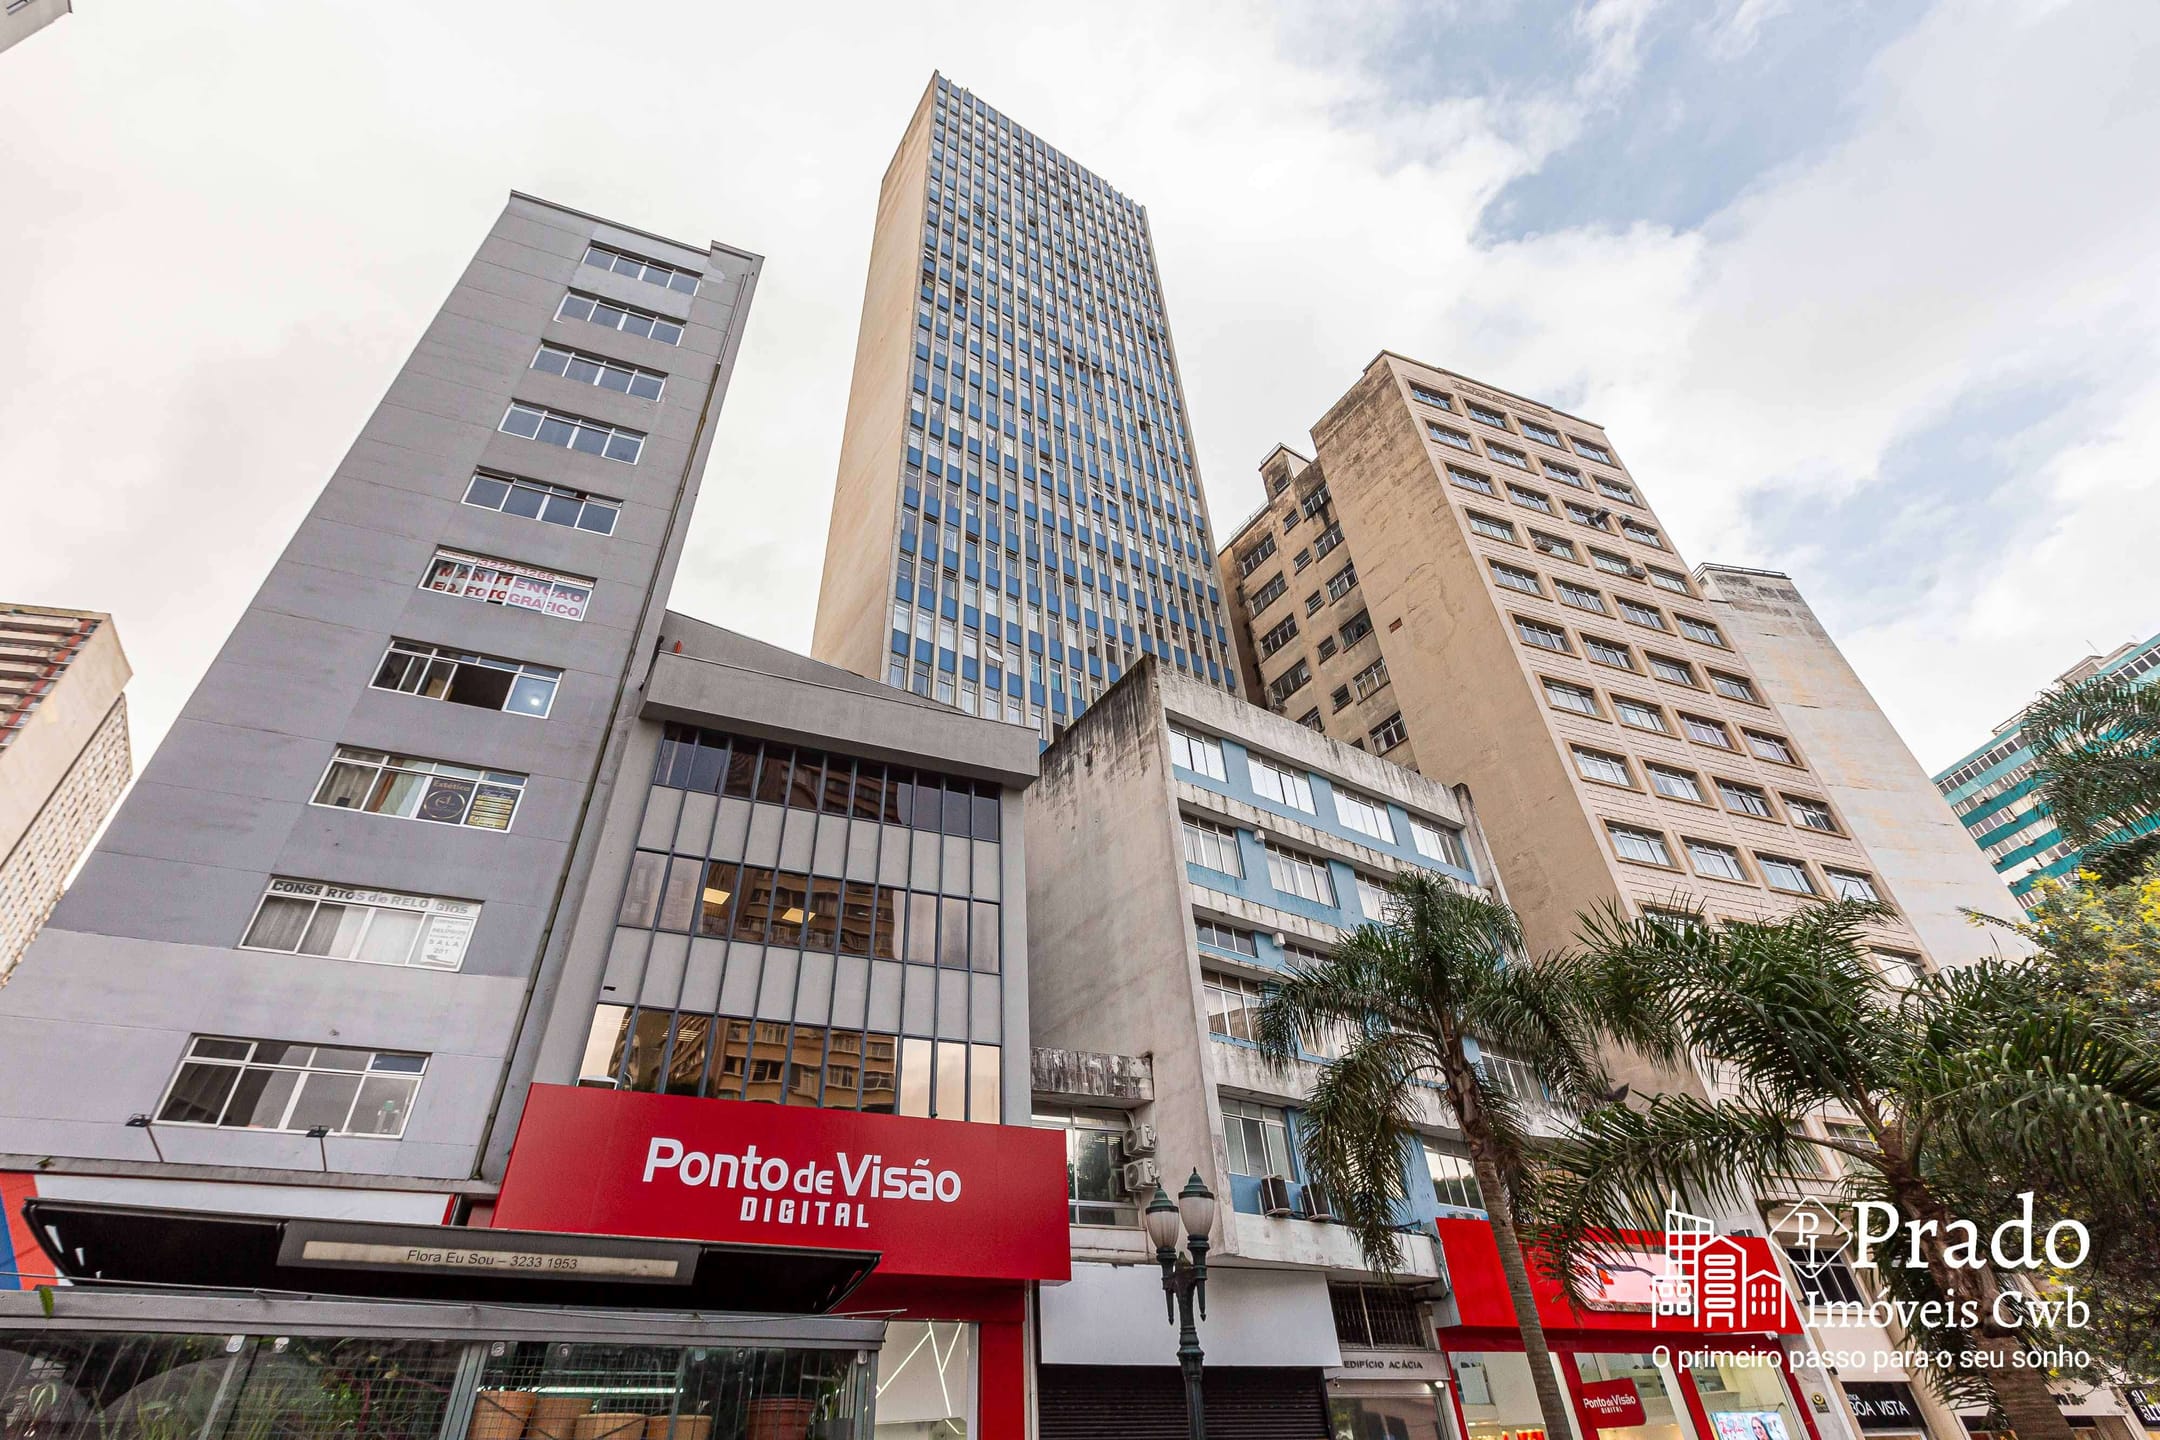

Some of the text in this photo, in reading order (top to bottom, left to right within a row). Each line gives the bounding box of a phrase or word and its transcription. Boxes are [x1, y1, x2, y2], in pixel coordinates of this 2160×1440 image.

[272, 881, 365, 901] CONSERTOS
[367, 892, 388, 904] de
[642, 1137, 962, 1203] Ponto de Visão
[740, 1196, 869, 1228] DIGITAL
[407, 1250, 578, 1270] Flora Eu Sou 3233 1953
[1343, 1359, 1423, 1369] EDIFÍCIO ACÁCIA
[1583, 1397, 1607, 1409] Ponto
[1611, 1393, 1636, 1405] Visão
[1875, 1400, 1911, 1416] VISTA
